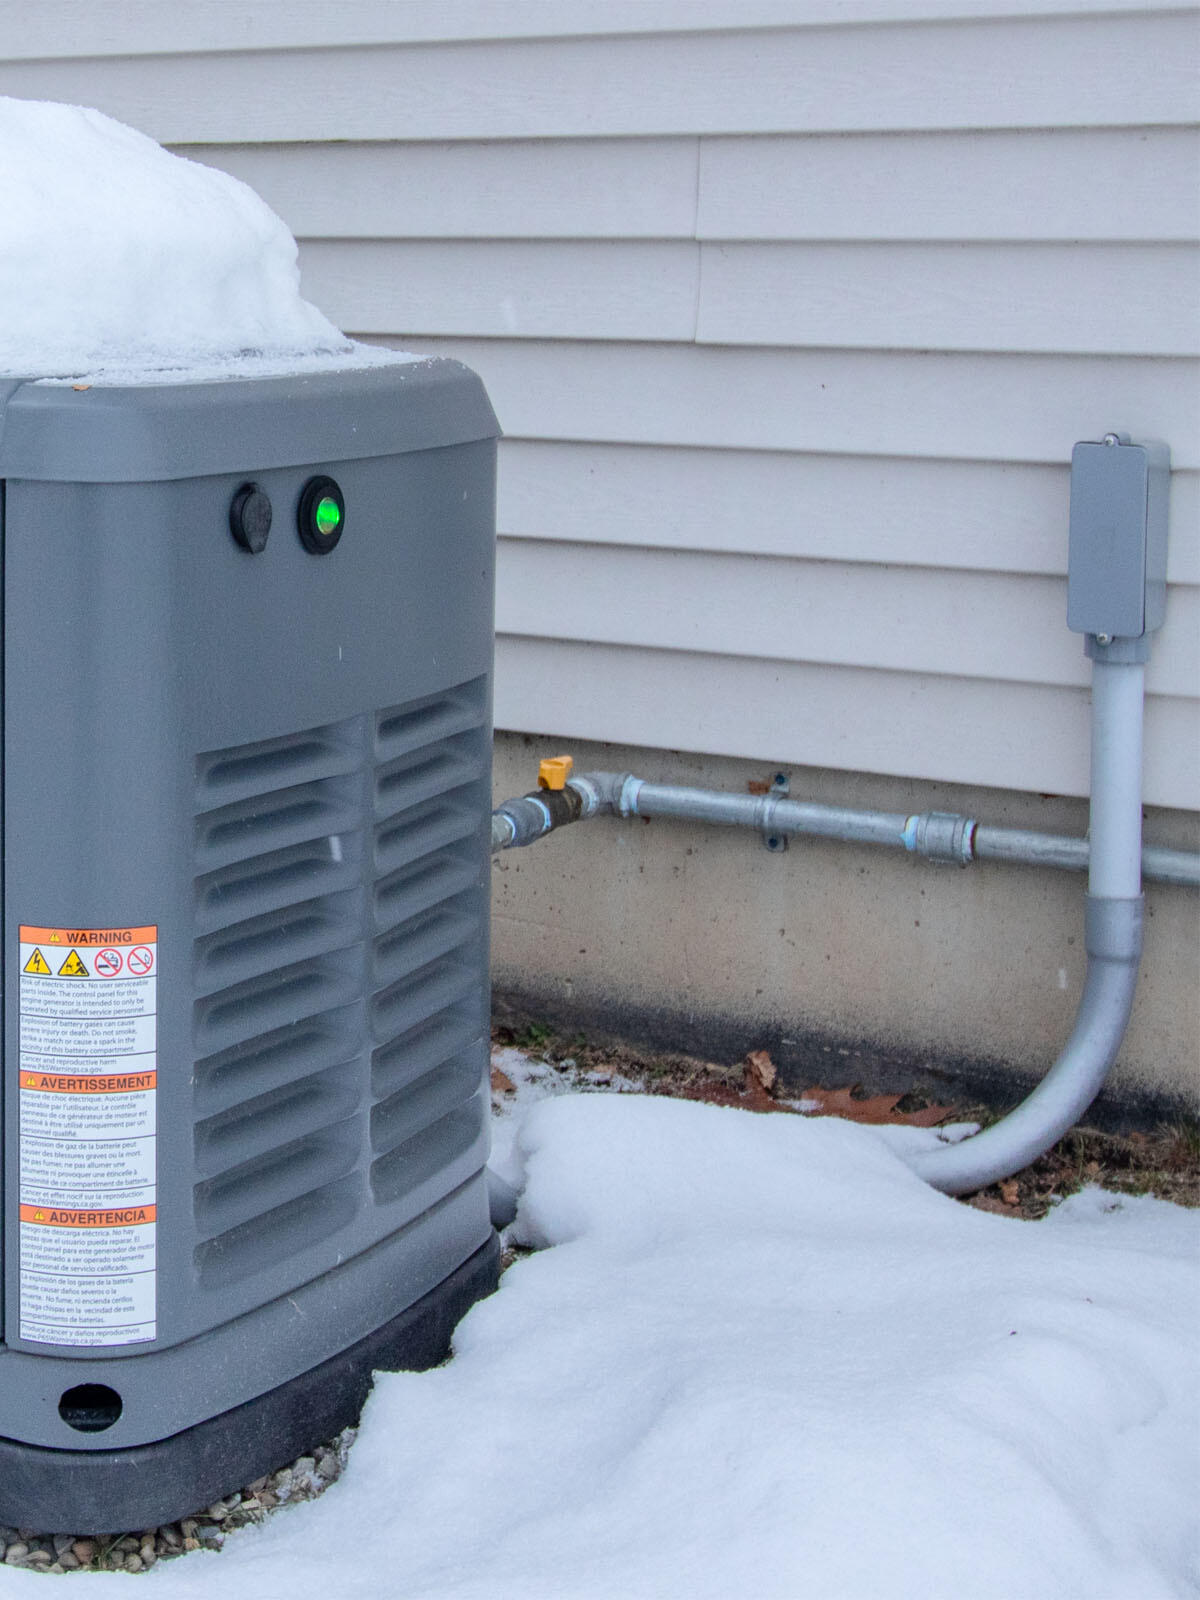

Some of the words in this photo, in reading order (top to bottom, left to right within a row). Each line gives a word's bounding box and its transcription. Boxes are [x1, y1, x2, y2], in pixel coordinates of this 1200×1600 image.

[66, 931, 132, 944] WARNING
[40, 1075, 152, 1090] AVERTISSEMENT
[49, 1210, 146, 1224] ADVERTENCIA
